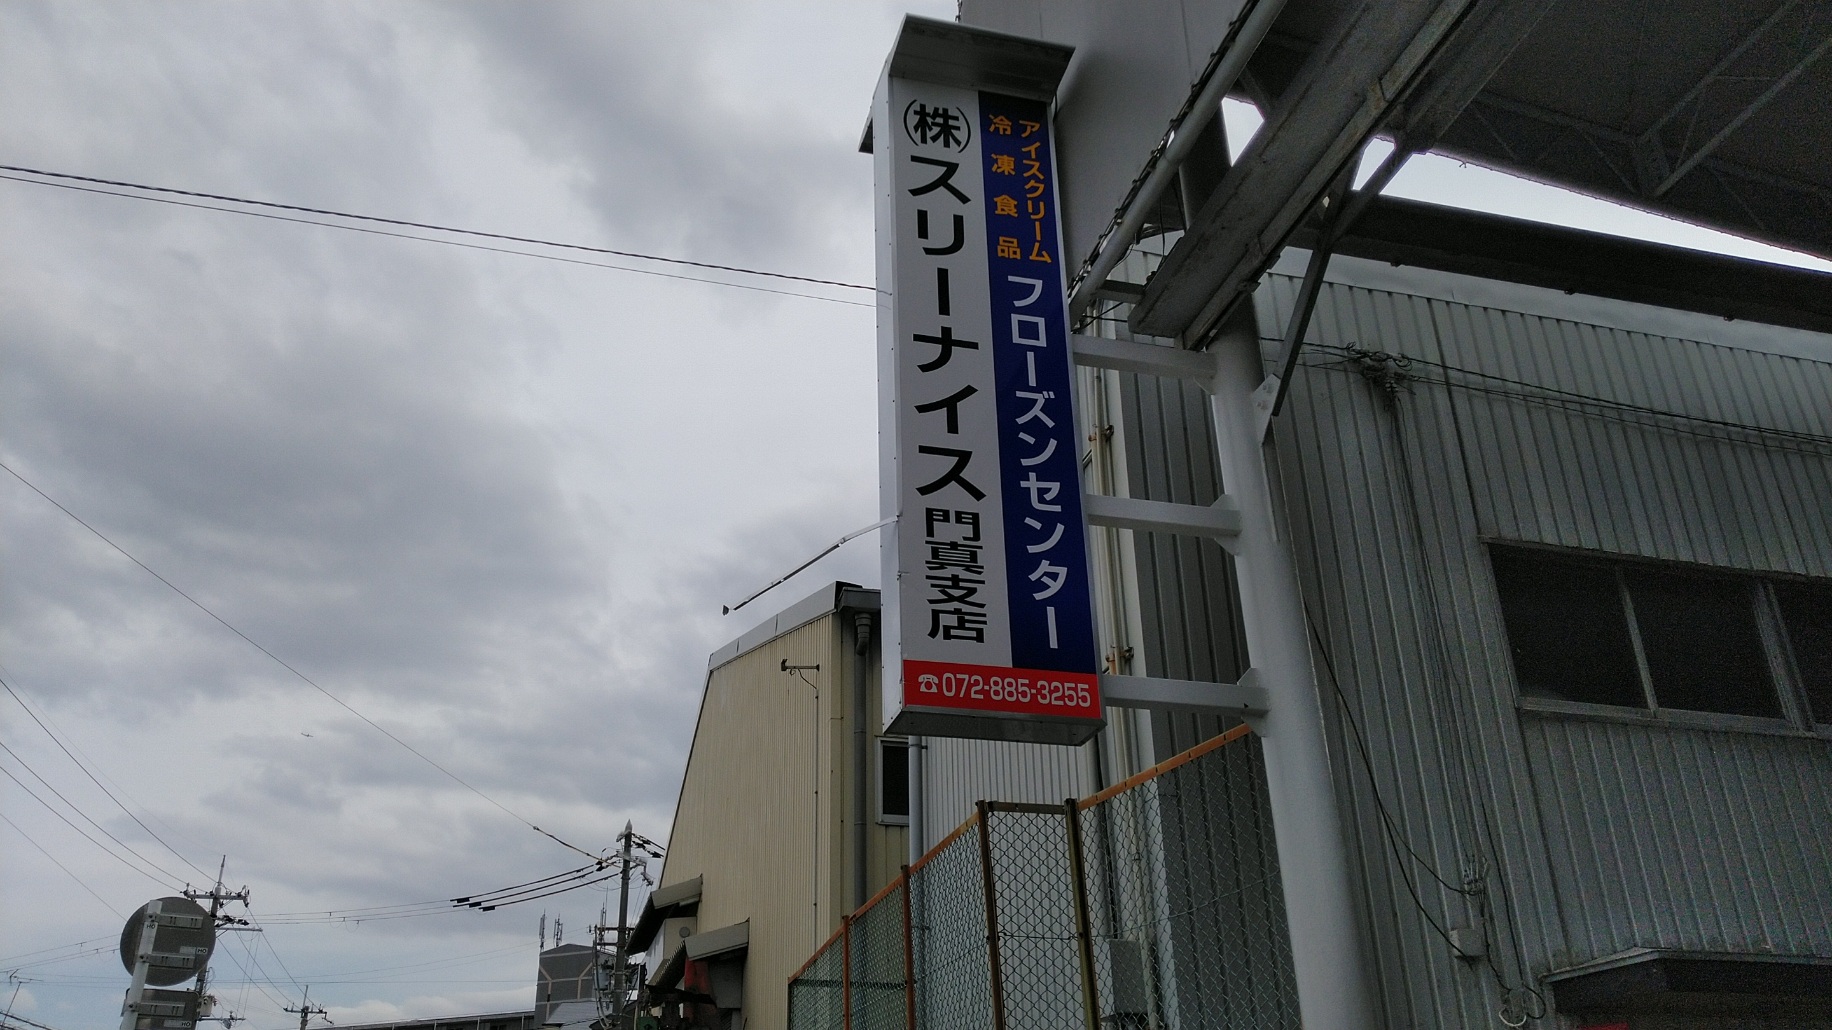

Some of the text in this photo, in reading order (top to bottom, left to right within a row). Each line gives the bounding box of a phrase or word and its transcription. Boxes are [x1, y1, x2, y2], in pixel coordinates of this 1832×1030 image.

[988, 113, 1021, 260] 冷凍食品
[1018, 119, 1052, 263] アイスクリーム
[1007, 275, 1068, 649] フローズンセンター
[942, 672, 1091, 707] 072-885-3255
